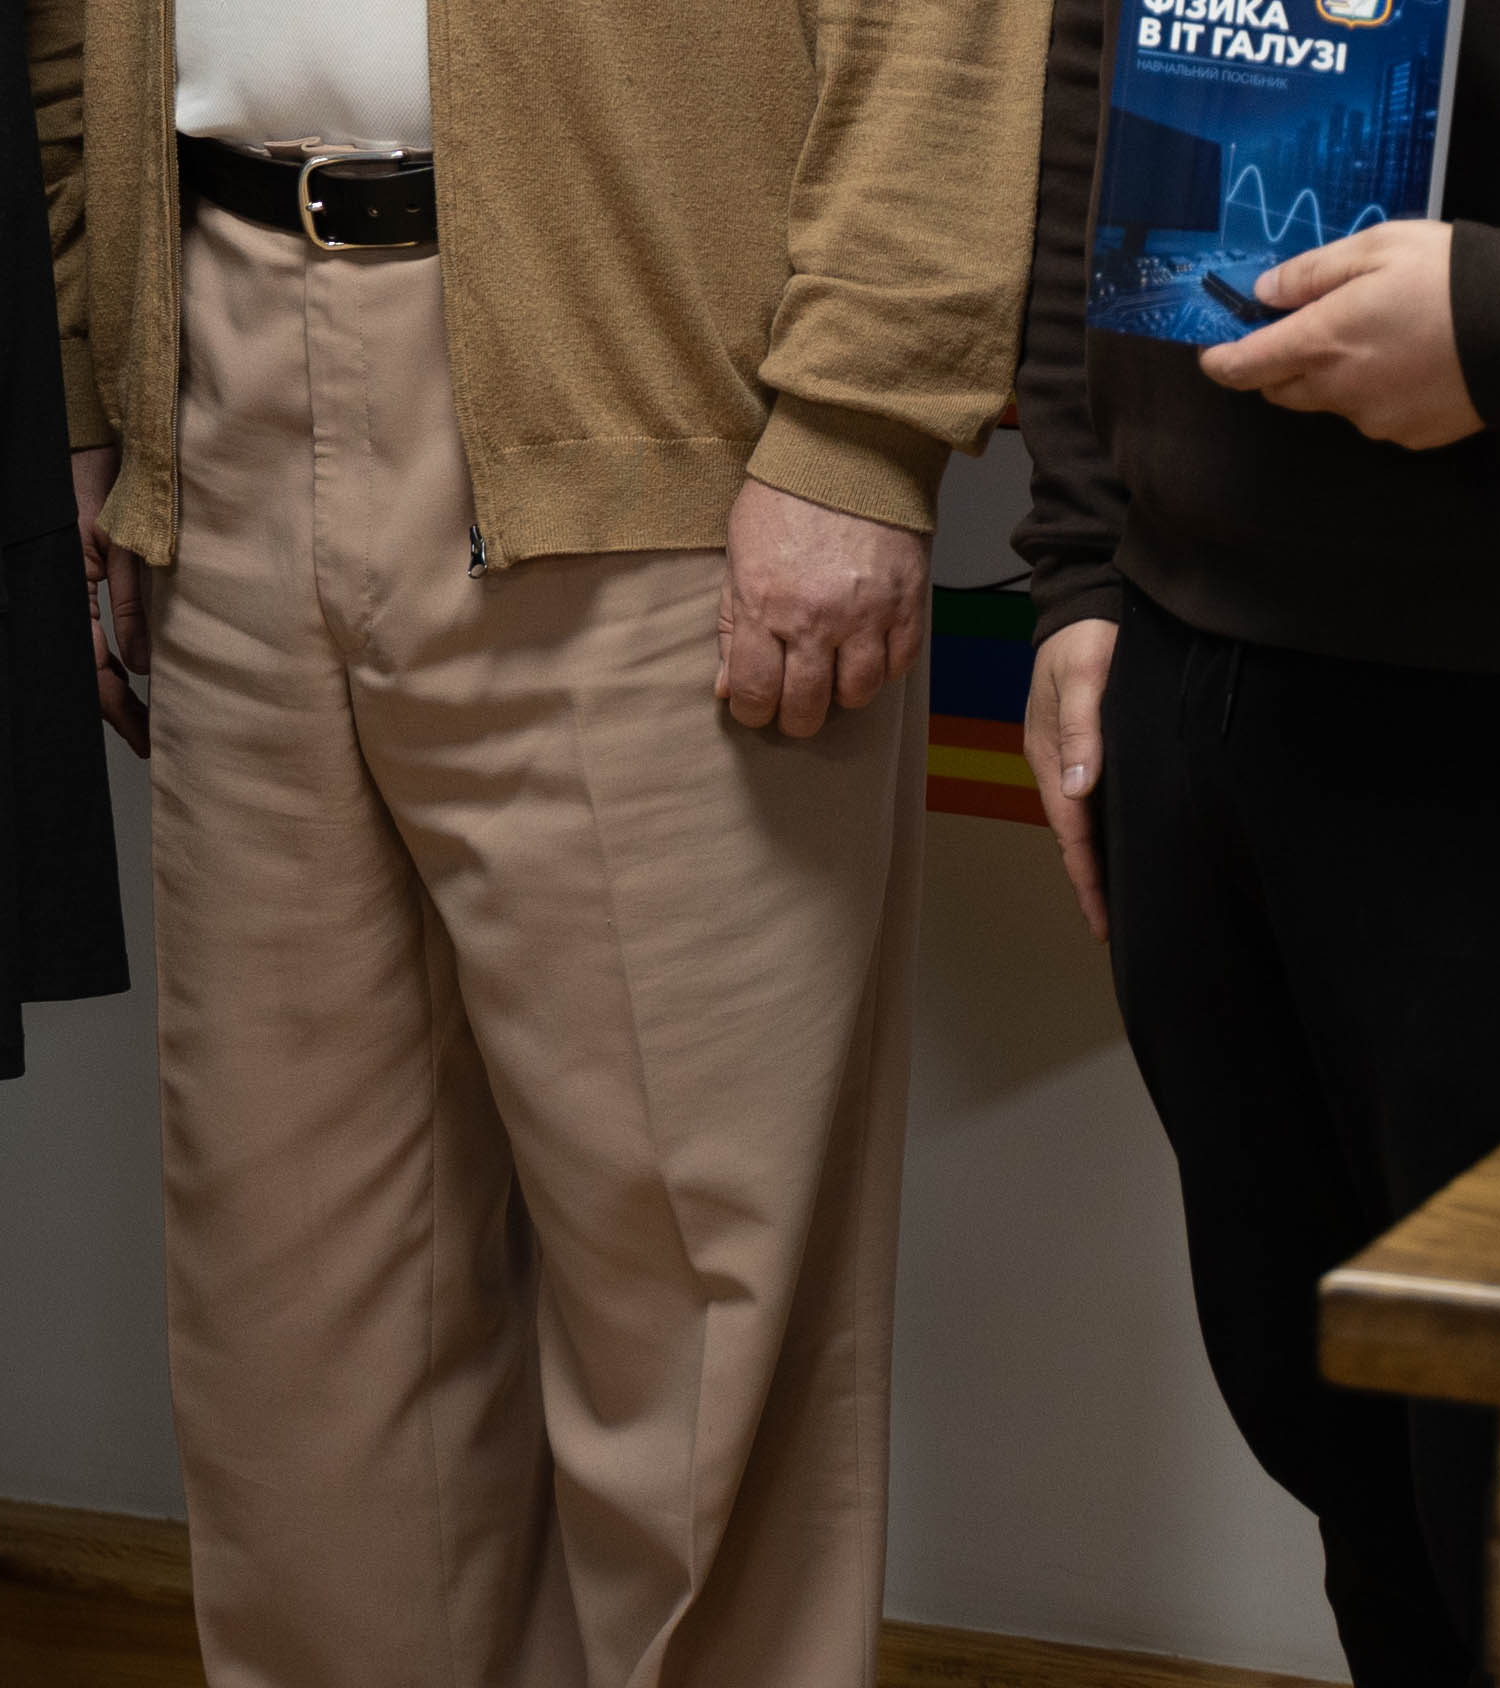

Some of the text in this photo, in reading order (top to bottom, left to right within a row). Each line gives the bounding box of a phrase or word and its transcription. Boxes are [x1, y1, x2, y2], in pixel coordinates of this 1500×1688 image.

[1138, 16, 1347, 73] В ІТ ГАЛУЗІ
